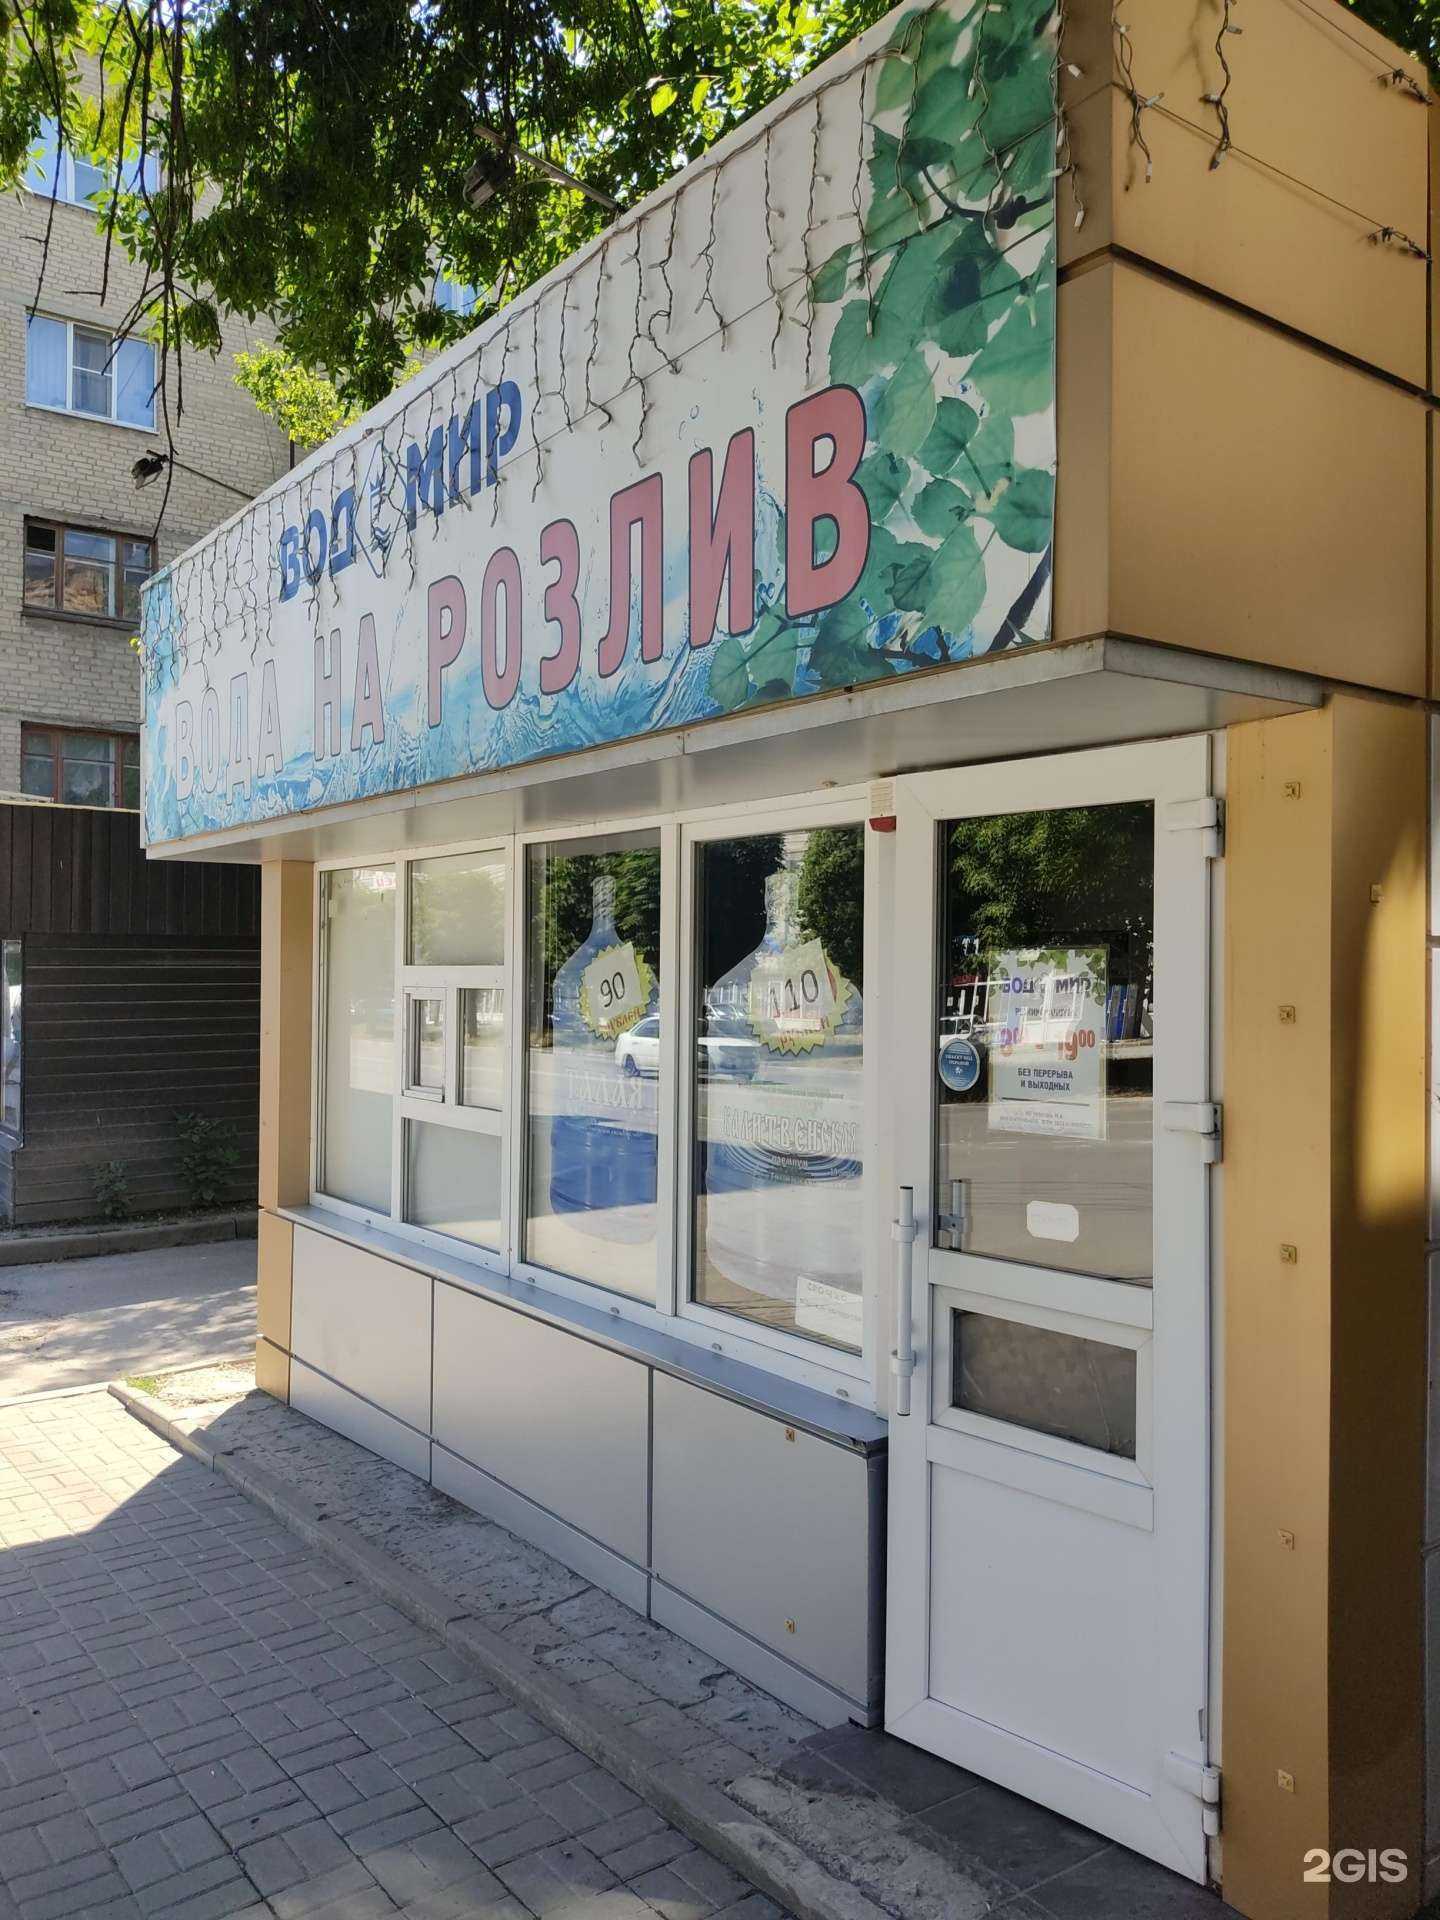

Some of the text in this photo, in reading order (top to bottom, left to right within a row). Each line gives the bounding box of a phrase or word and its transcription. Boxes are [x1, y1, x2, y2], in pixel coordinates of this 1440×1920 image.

[175, 383, 871, 806] ВОДА НА РОЗЛИВ
[600, 971, 625, 1009] 90
[769, 968, 819, 1019] 110
[1018, 1067, 1074, 1080] БЕЗ ПЕРЕРЫВА
[1020, 1079, 1071, 1092] И ВЫХОДНЫХ
